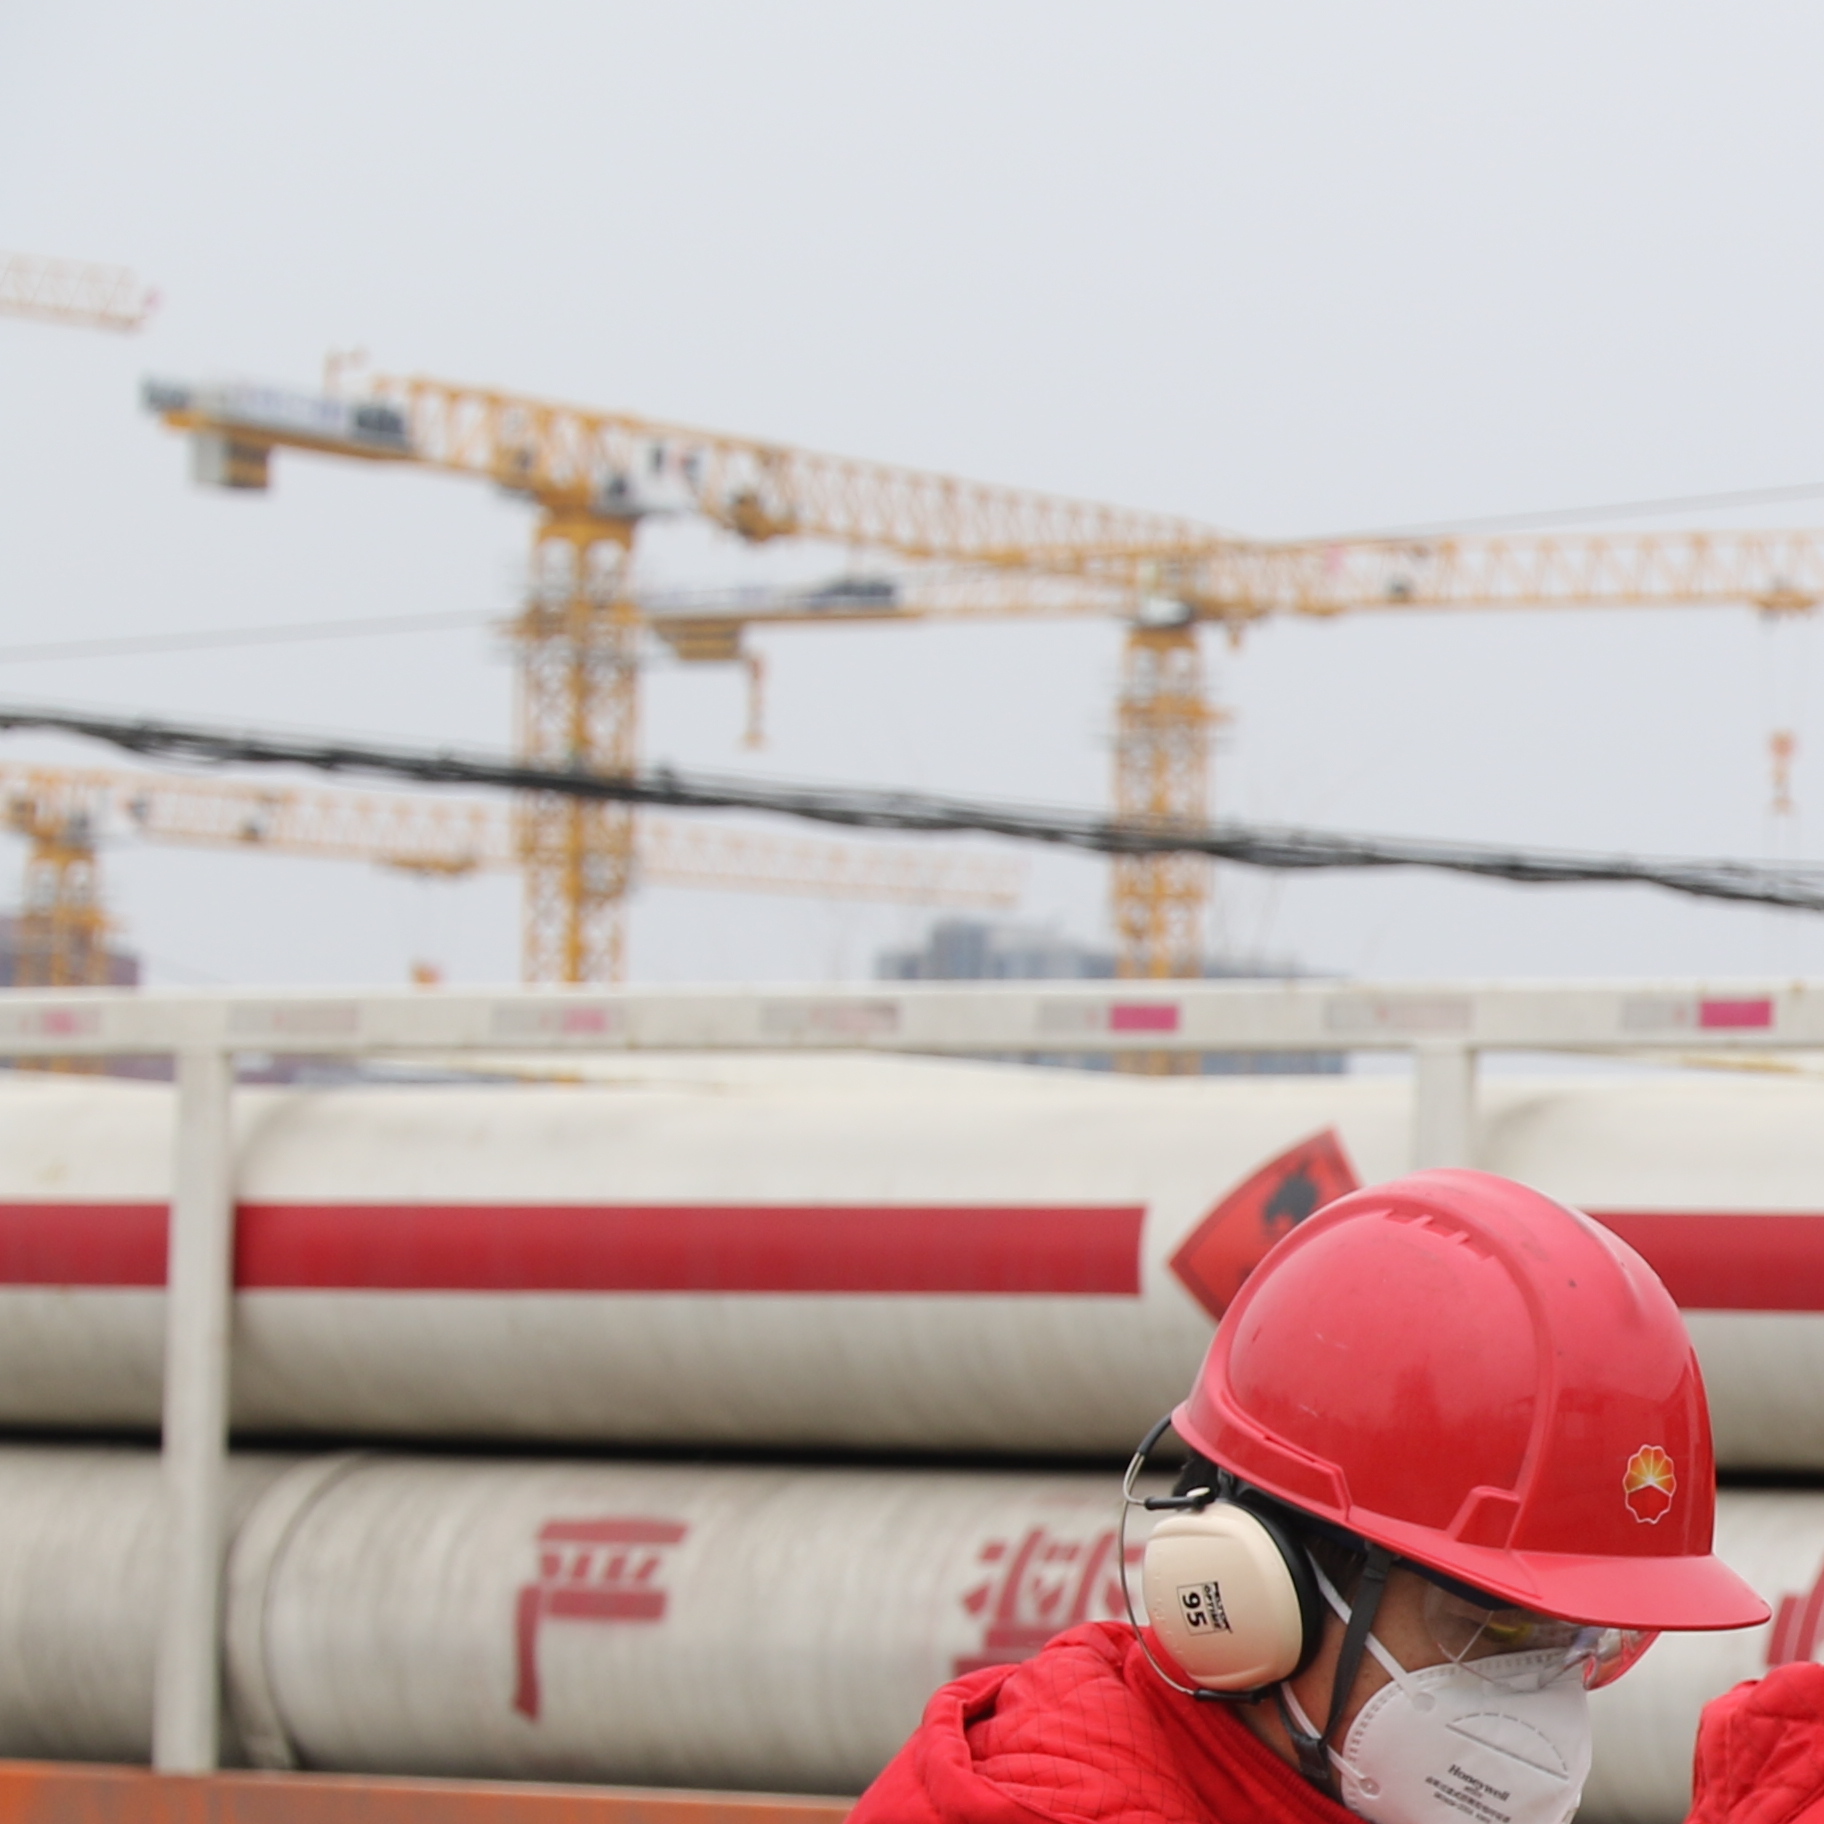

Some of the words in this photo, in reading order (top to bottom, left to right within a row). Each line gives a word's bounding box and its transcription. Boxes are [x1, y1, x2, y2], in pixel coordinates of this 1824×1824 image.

[1182, 1592, 1208, 1628] 95
[1204, 1585, 1221, 1629] OPTIME
[1448, 1763, 1510, 1803] Honeywell
